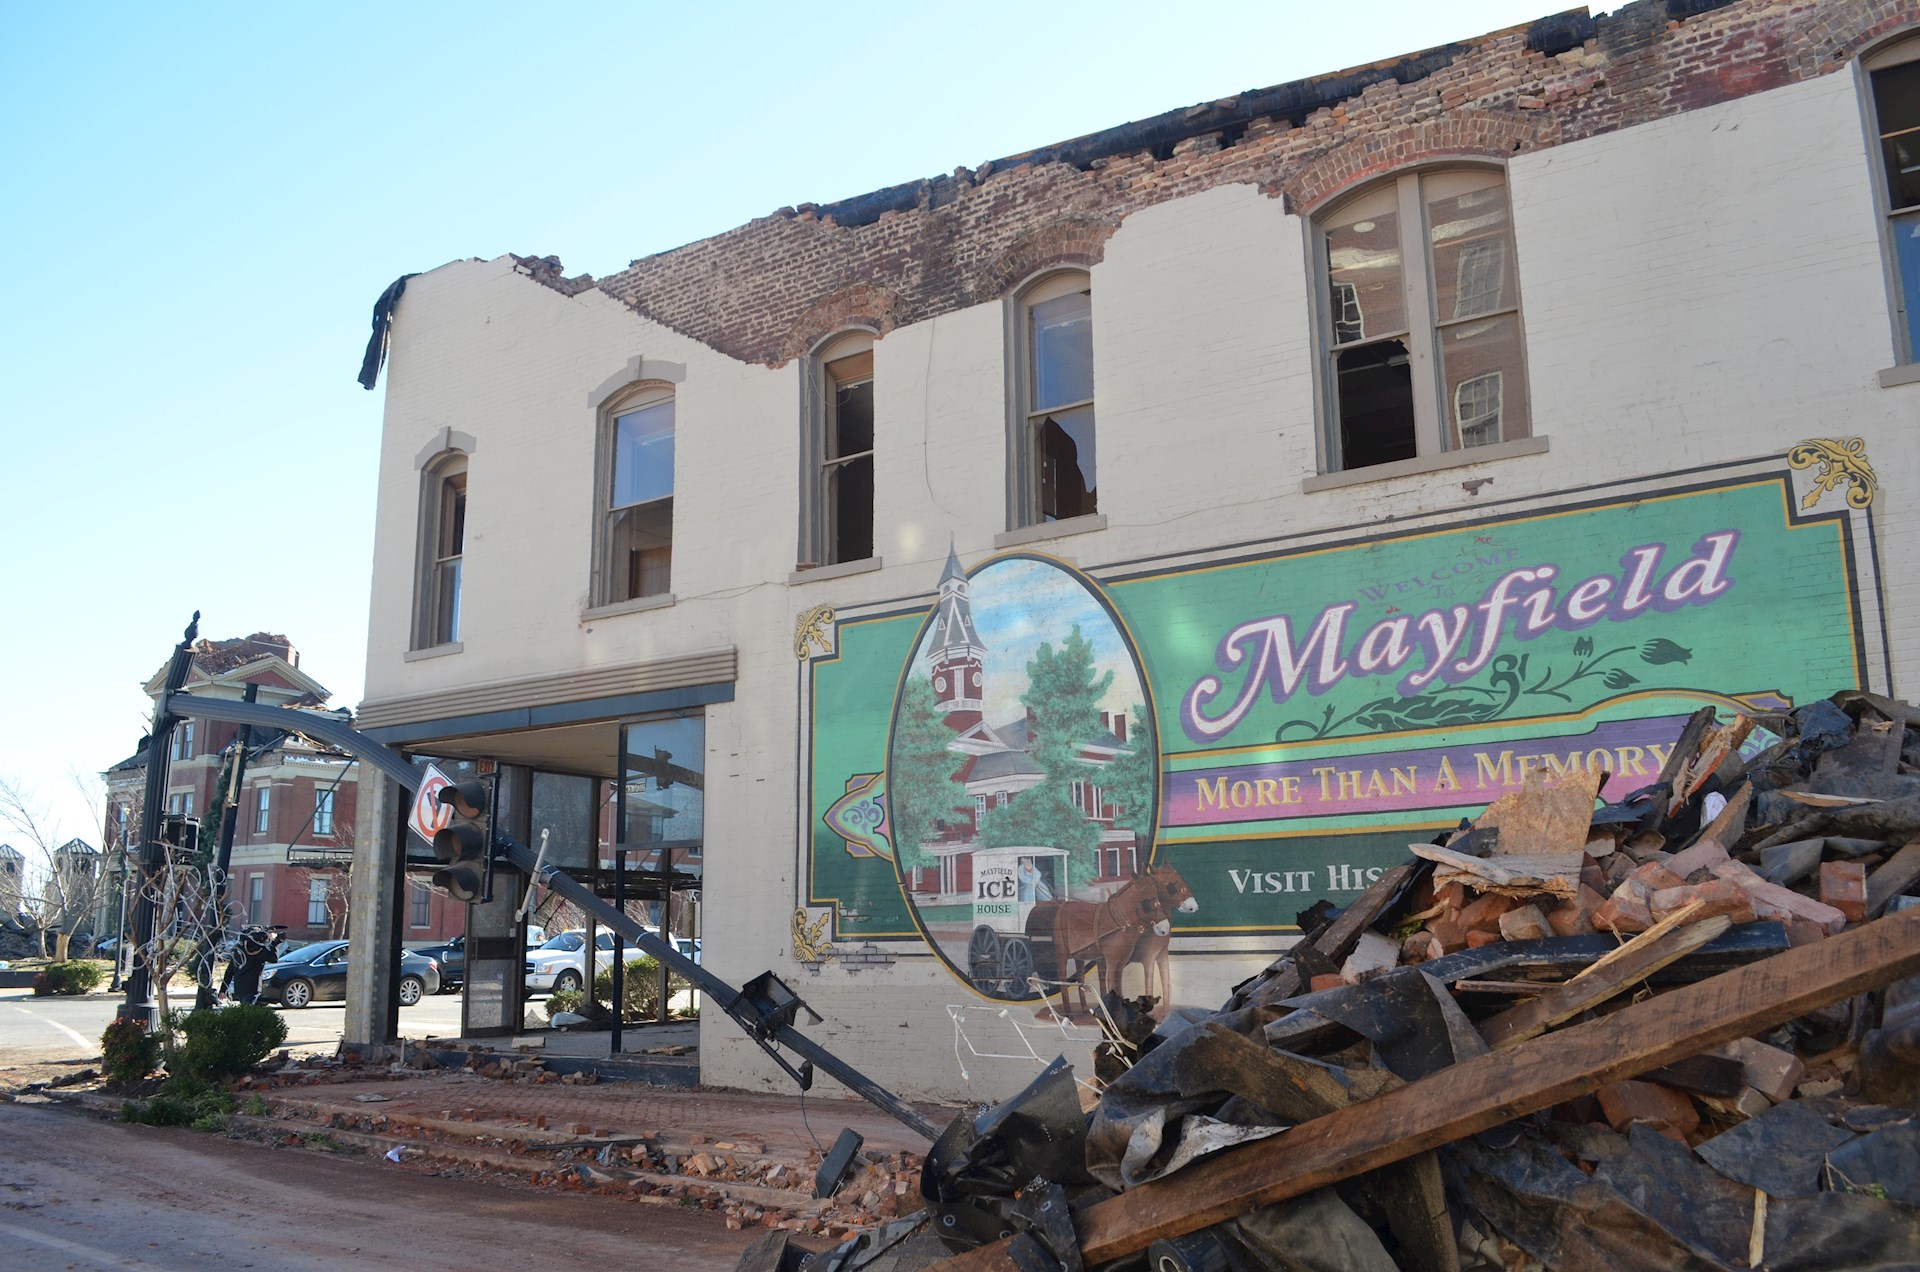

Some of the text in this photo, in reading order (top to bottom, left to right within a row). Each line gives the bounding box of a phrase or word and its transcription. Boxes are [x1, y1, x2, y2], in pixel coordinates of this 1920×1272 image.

[1186, 531, 1740, 739] Mayfield
[480, 759, 495, 773] EXIT
[1434, 755, 1462, 792] A
[980, 867, 1013, 879] MAYFIELD
[1327, 864, 1389, 891] HIS
[977, 880, 1016, 900] ICE
[977, 904, 1012, 914] HOUSE
